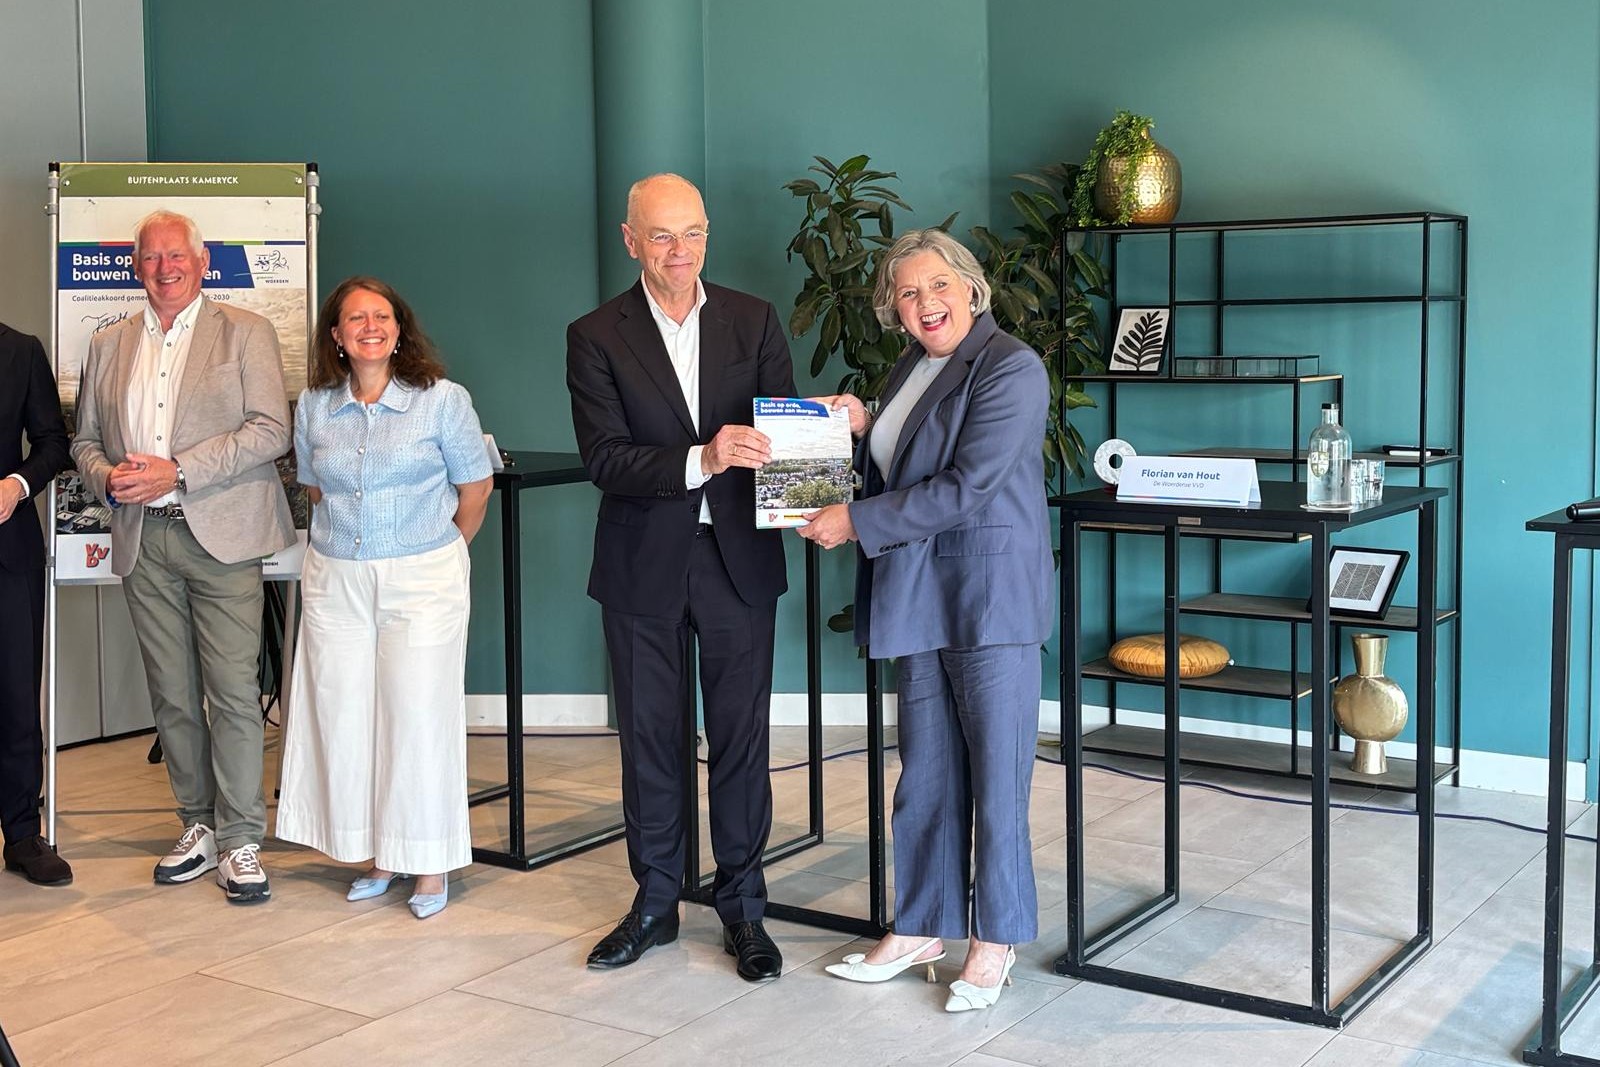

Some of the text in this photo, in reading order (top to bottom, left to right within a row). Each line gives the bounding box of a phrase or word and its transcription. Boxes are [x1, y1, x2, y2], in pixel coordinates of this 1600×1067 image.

[127, 176, 239, 184] BUITENPLAATS KAMERYCK
[72, 253, 133, 268] Basis op
[72, 268, 131, 281] bouwen
[72, 294, 125, 302] Coalitieakkoord
[1141, 469, 1221, 480] Florian van Hout
